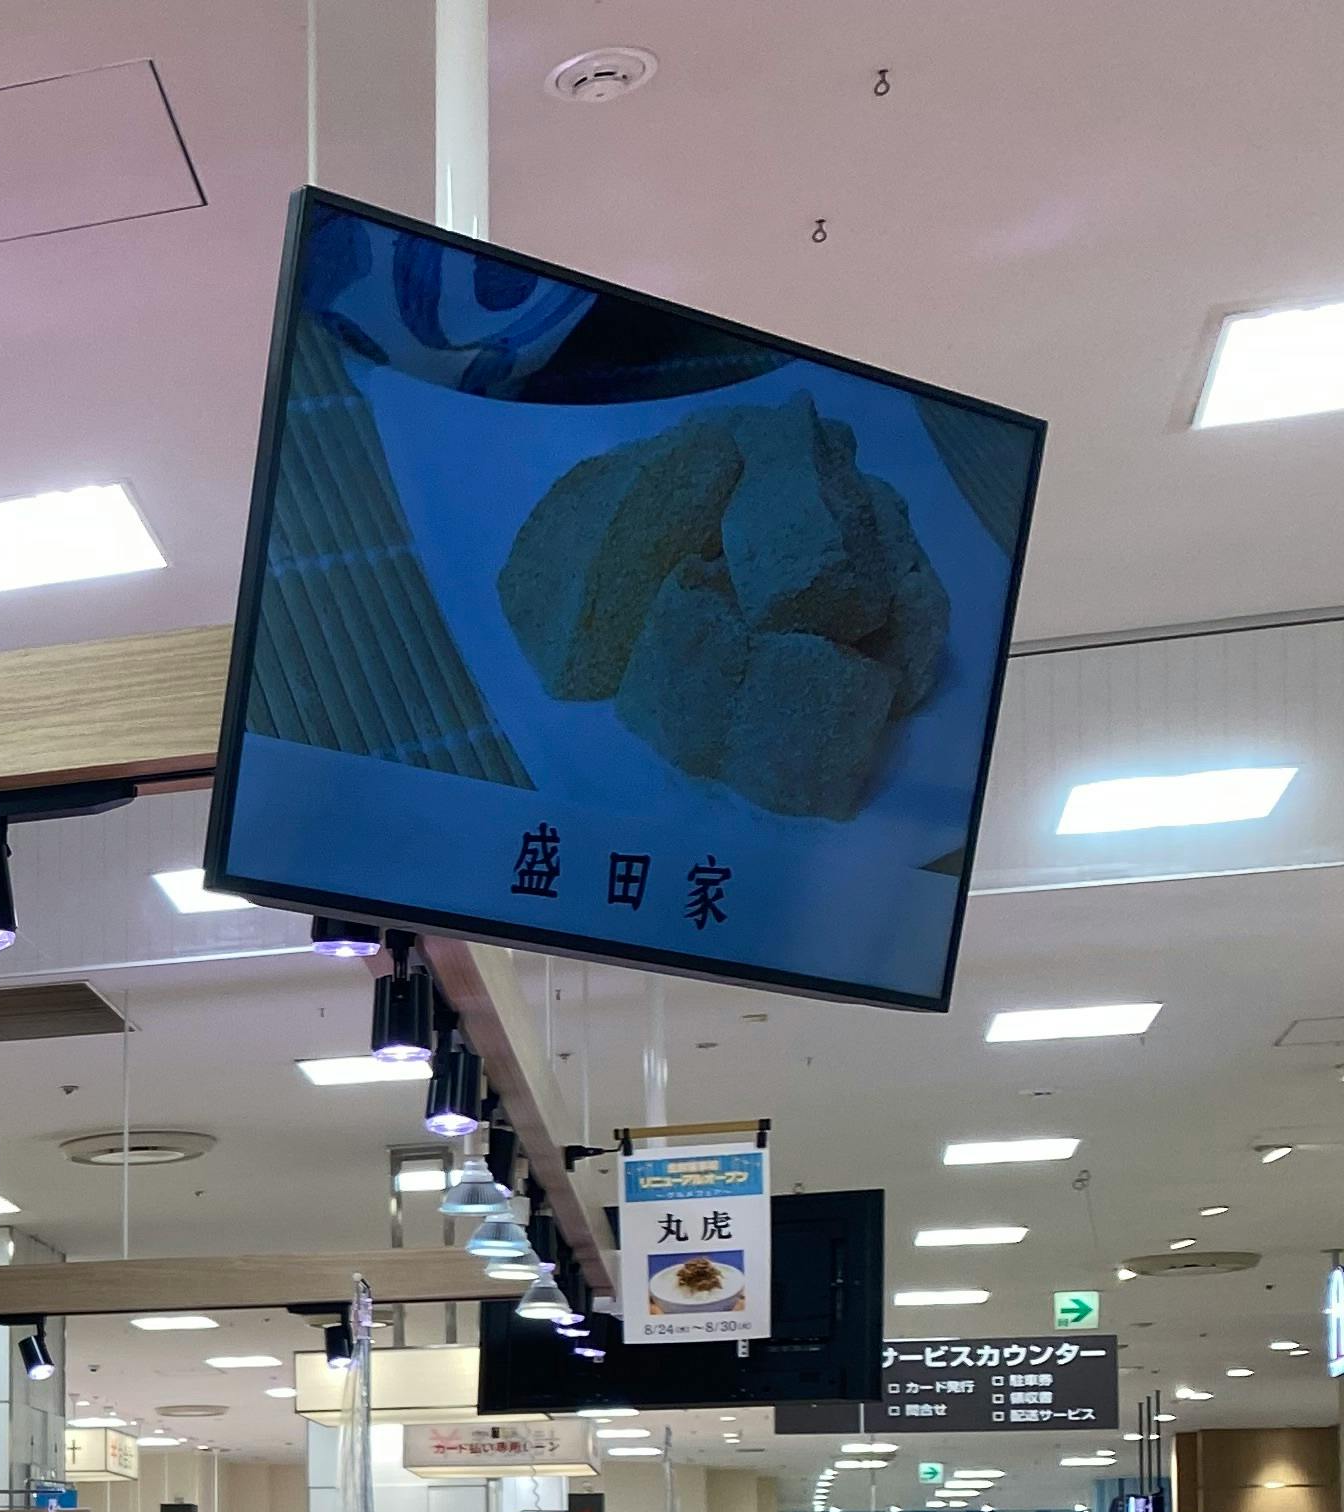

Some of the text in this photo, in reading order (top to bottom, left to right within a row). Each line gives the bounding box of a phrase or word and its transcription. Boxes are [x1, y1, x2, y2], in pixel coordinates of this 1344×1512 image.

[511, 822, 732, 930] 盛田家
[657, 1210, 733, 1243] 丸虎
[905, 1380, 976, 1394] カード発行
[905, 1403, 948, 1417] 問合せ
